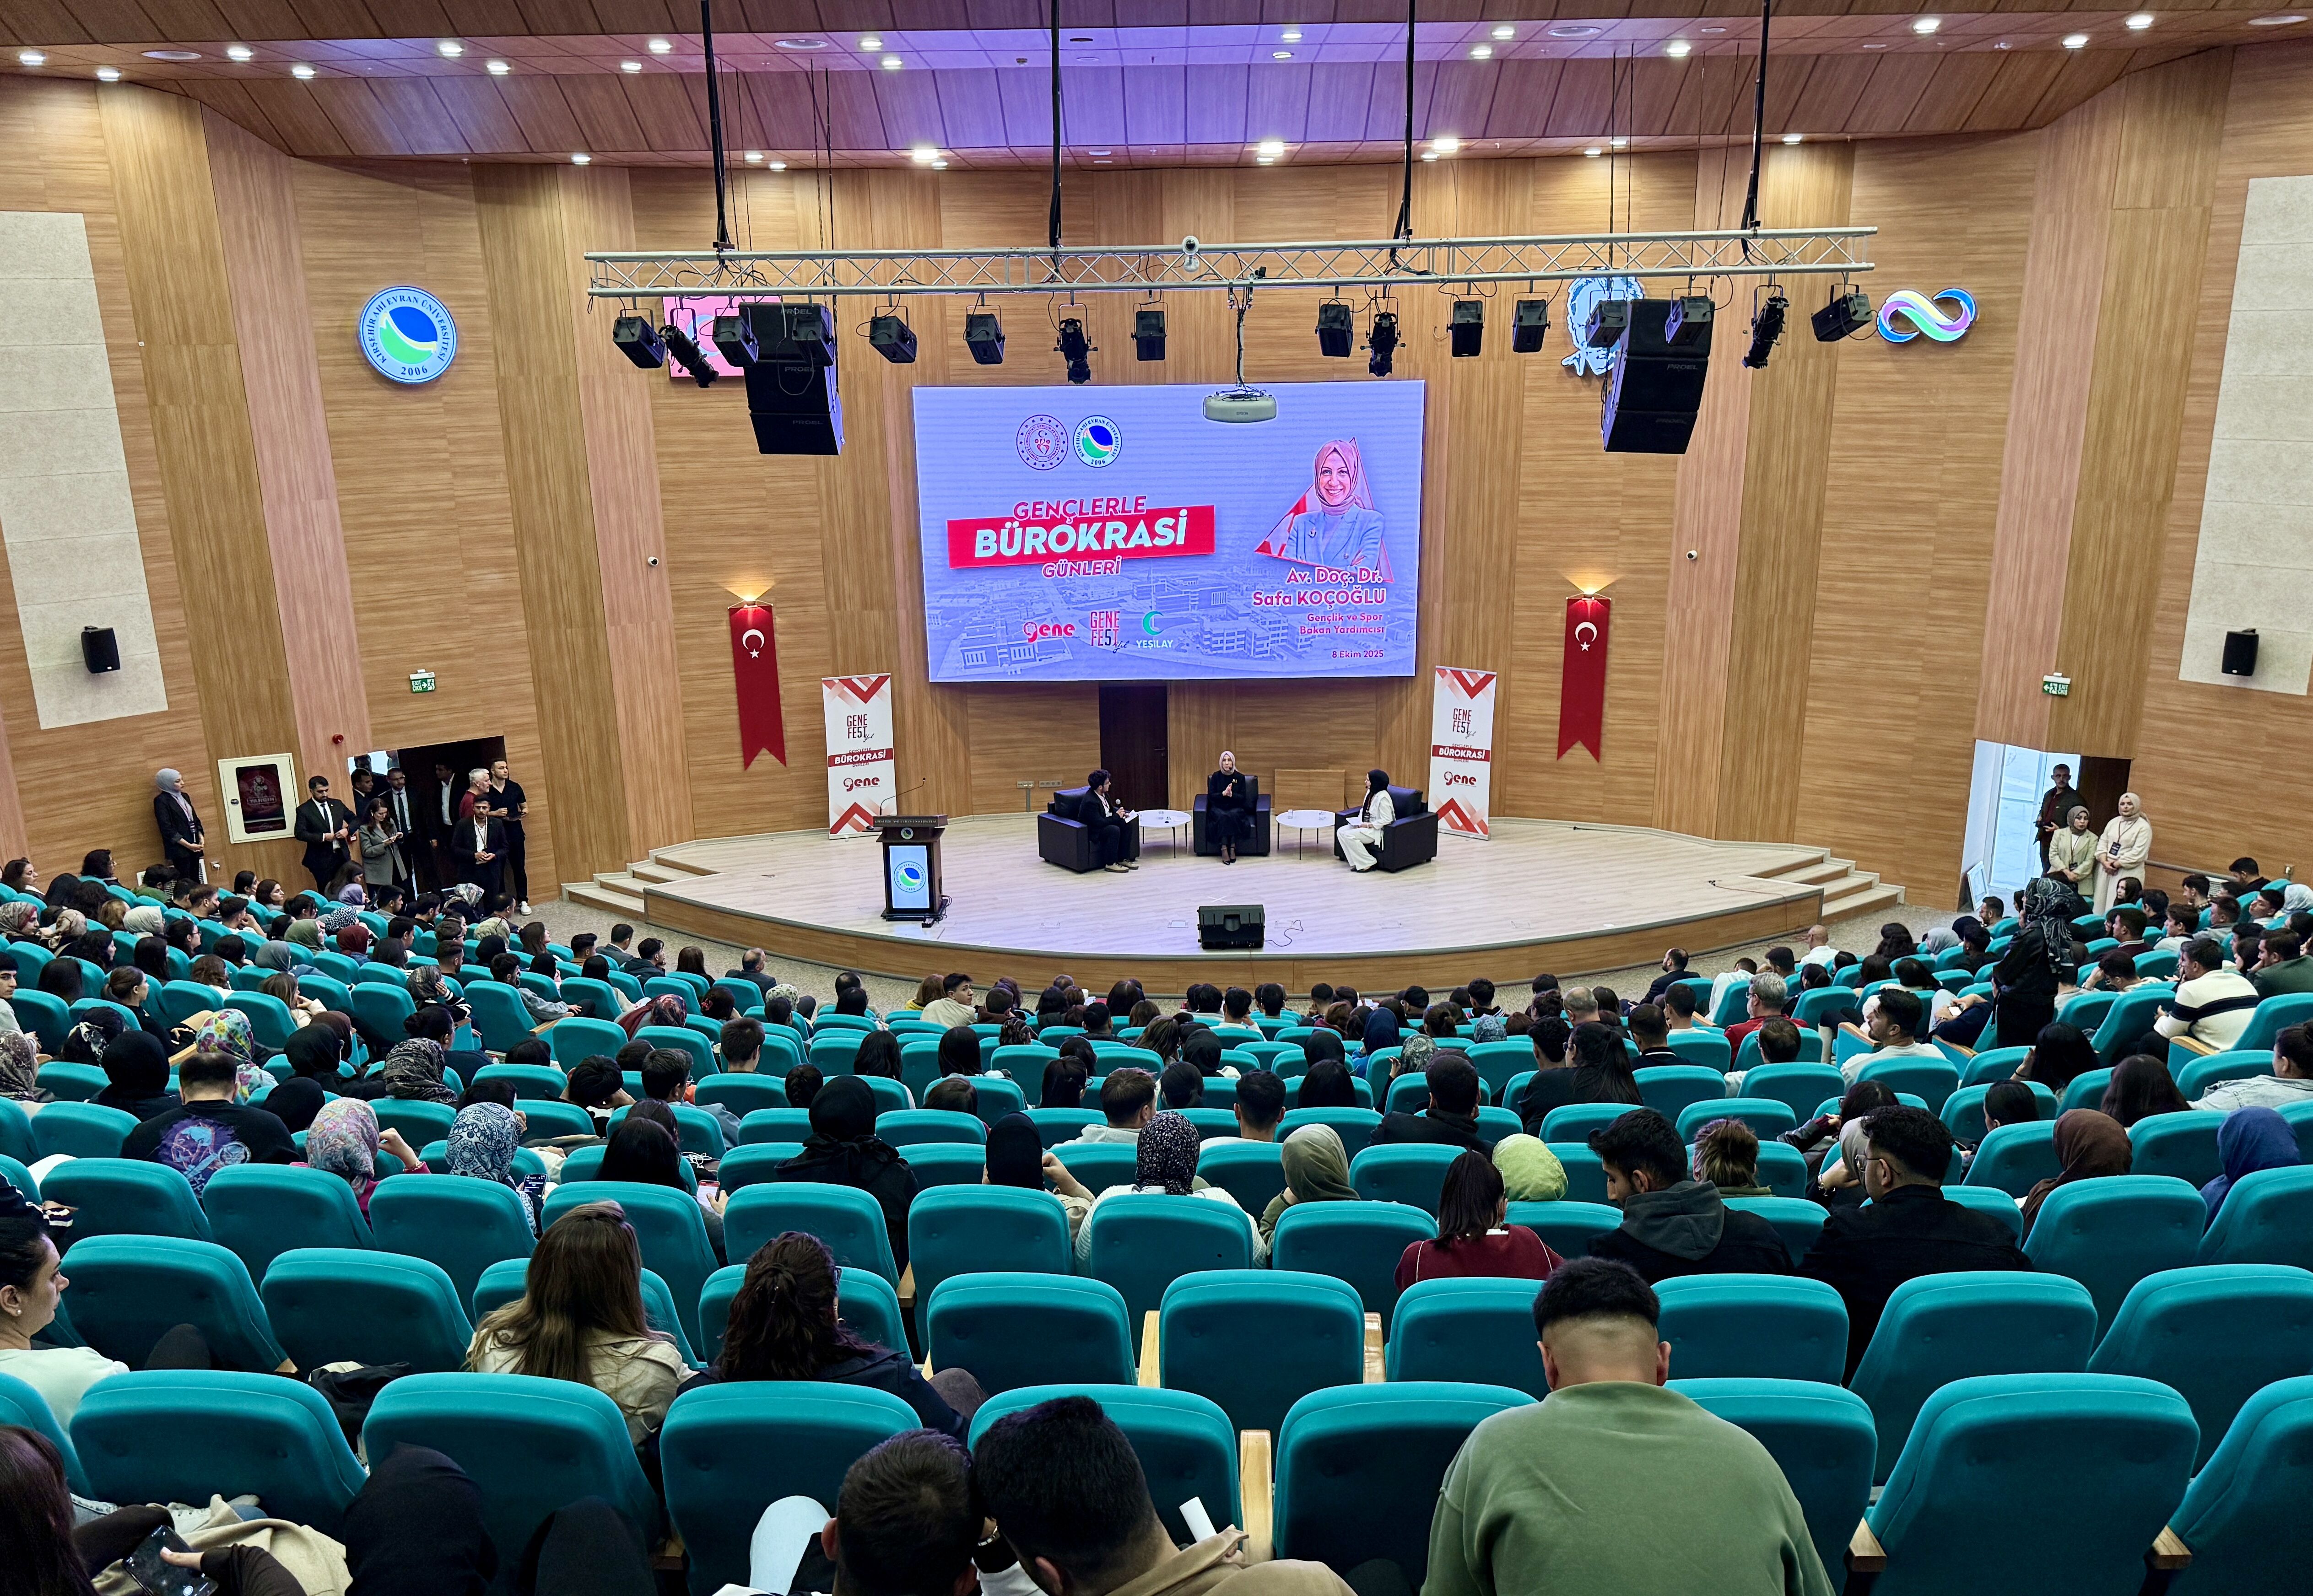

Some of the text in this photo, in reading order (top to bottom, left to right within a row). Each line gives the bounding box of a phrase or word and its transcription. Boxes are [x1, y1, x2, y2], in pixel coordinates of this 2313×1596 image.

[386, 295, 420, 306] EVRAN
[421, 300, 450, 361] ÜNİVERSİTESİ
[401, 365, 427, 376] 2006
[1013, 496, 1146, 523] GENÇLERLE
[974, 509, 1188, 557] BÜROKRASİ
[1043, 555, 1122, 578] GÜNLERİ
[1286, 567, 1382, 587] Av. Doç. Dr.
[1253, 586, 1385, 609] Safa KOÇOĞLU
[1090, 611, 1120, 628] GENE
[1307, 613, 1344, 624] Gençlik
[1360, 613, 1383, 623] Spor
[1023, 621, 1075, 643] gene
[1300, 625, 1384, 635] Bakan Yardımcısı
[1340, 650, 1361, 658] Ekim
[847, 714, 867, 727] GENE
[1453, 708, 1472, 722] GENE
[834, 749, 886, 764] BÜROKRASİ
[1439, 747, 1486, 759] BÜROKRASİ
[843, 777, 880, 792] gene
[1444, 771, 1476, 786] gene
